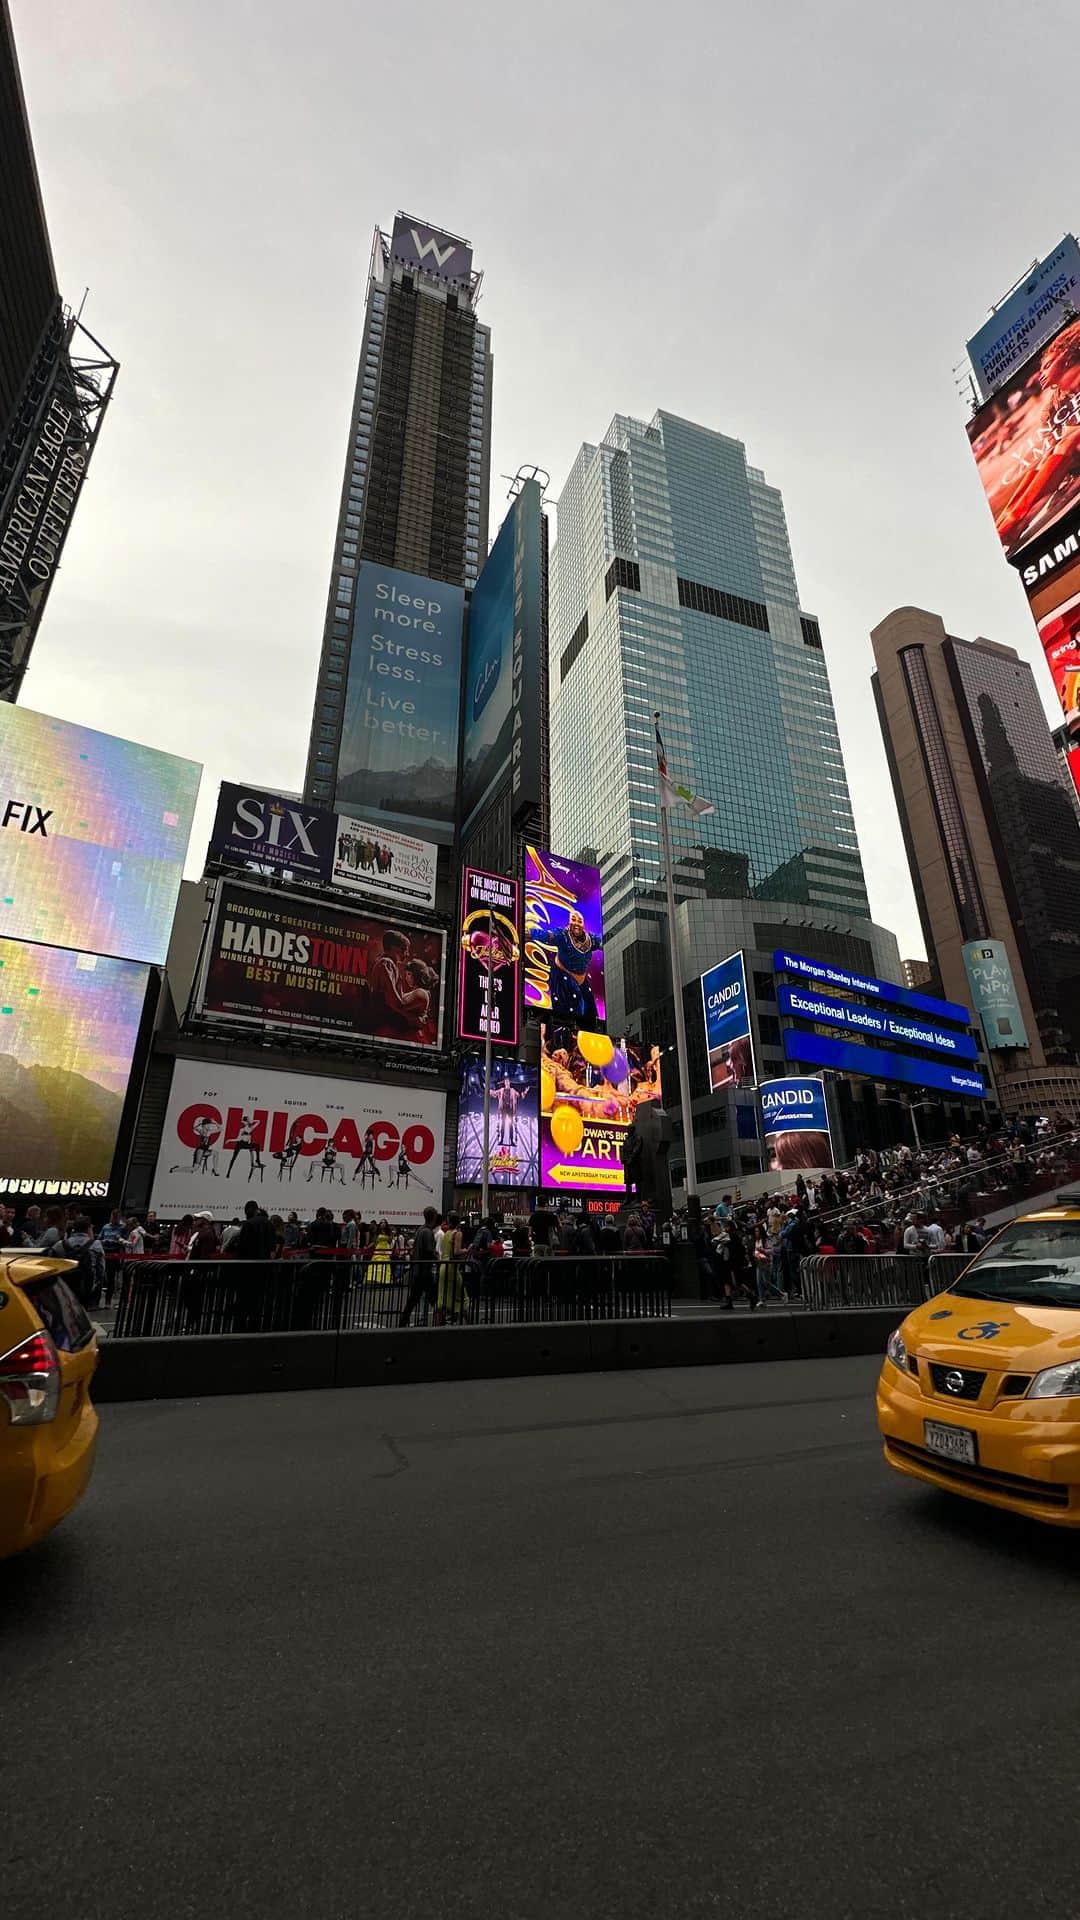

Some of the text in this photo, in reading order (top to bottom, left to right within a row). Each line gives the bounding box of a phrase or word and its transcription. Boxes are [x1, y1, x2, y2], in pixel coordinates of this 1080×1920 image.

[409, 228, 457, 269] W
[979, 272, 1067, 366] EXPERTISE ACROSS
[983, 275, 1077, 376] PUBLIC AND PRIVATE
[986, 338, 1030, 385] MARKETS
[0, 397, 74, 595] AMERICAN EAGLE
[27, 446, 87, 581] OUTFITTERS
[1023, 529, 1080, 586] SAM
[375, 582, 443, 617] Sleep
[373, 606, 443, 636] more.
[369, 654, 422, 684] less.
[371, 633, 443, 667] Stress
[366, 687, 416, 715] Live
[511, 627, 523, 795] SQUARE
[364, 708, 448, 747] better.
[1, 798, 54, 839] FIX
[231, 797, 320, 857] SIX
[393, 863, 433, 885] WRONG
[470, 886, 480, 900] ON
[483, 875, 500, 892] MOST
[499, 883, 511, 896] FUN
[226, 901, 370, 943] BROADWAY'S GREATEST LOVE STORY
[218, 949, 256, 966] WINNER!
[266, 958, 289, 972] TONY
[326, 970, 369, 987] INCLUDING
[245, 966, 343, 997] BEST MUSICAL
[783, 956, 880, 994] The Morgan Stanley Interview
[972, 964, 1008, 980] PLAY
[707, 982, 741, 1009] CANDID
[979, 980, 1010, 996] NPR
[790, 994, 845, 1020] Exceptional
[846, 1009, 882, 1030] Leaders
[888, 1020, 935, 1043] Exceptional
[934, 1033, 956, 1049] Ideas
[761, 1089, 815, 1109] CANDID
[951, 1075, 983, 1092] Morgan Stanley
[176, 1102, 436, 1165] CHICAGO
[559, 1170, 619, 1181] NEW AMSTERDAM THEATRE
